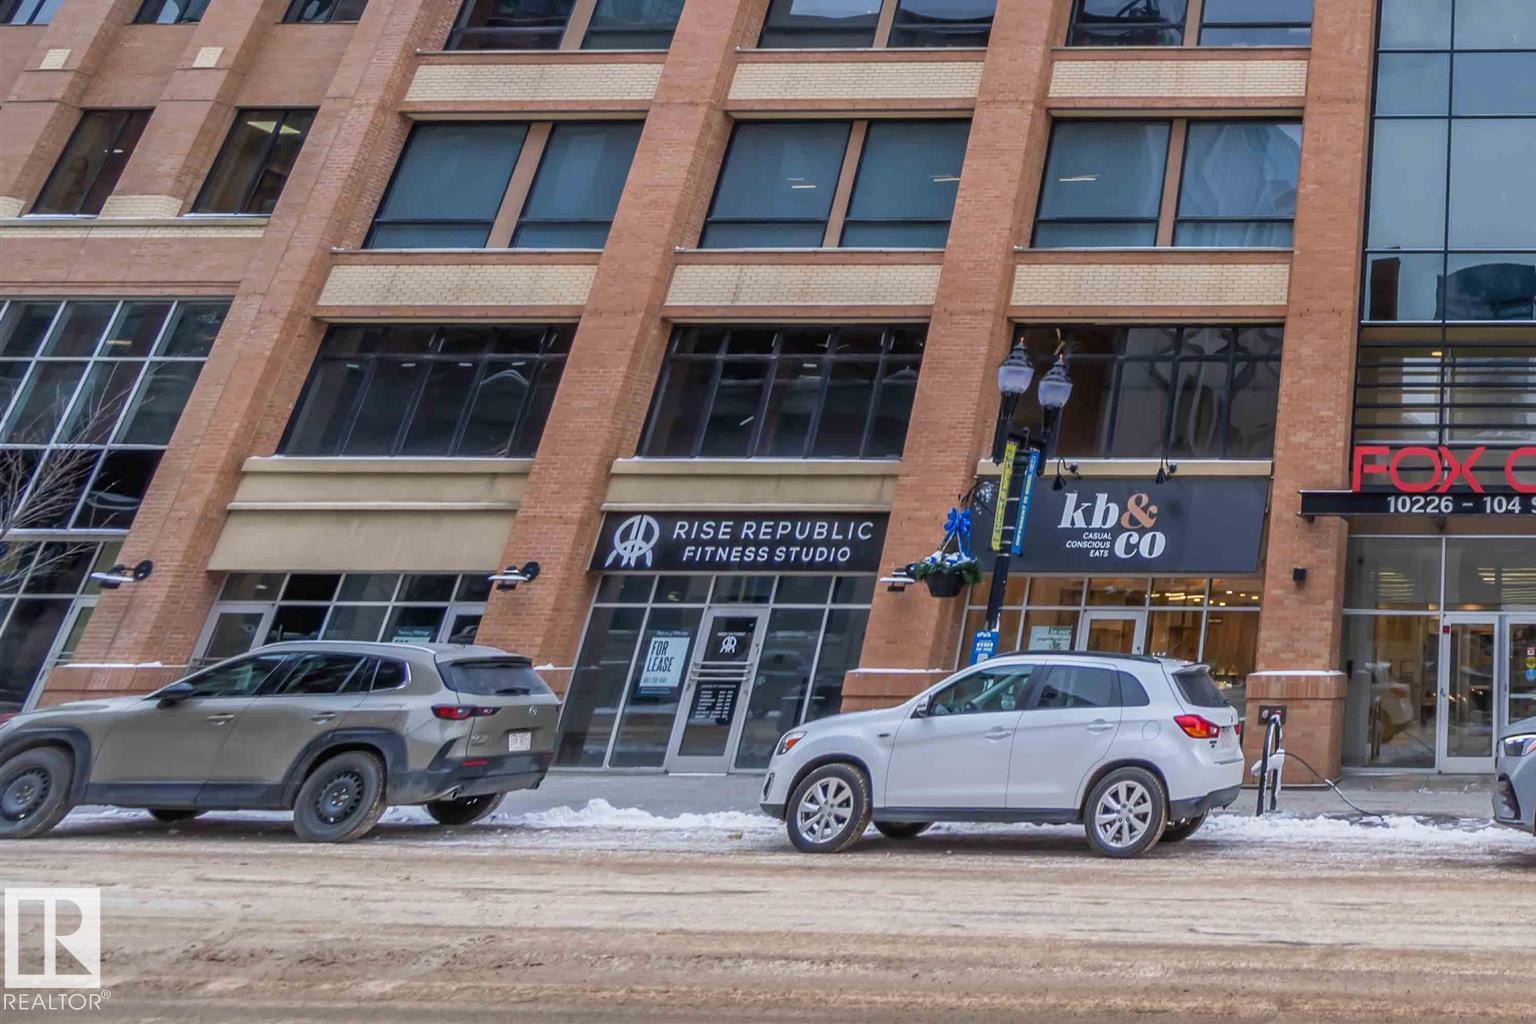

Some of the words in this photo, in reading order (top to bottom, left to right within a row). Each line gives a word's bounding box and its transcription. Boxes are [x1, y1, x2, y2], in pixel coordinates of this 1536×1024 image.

[1352, 446, 1486, 494] FOX
[1387, 496, 1453, 514] 10226
[1483, 496, 1521, 514] 104
[673, 521, 734, 540] RISE
[740, 521, 874, 540] REPUBLIC
[1083, 532, 1113, 540] CASUAL
[1066, 540, 1111, 549] CONSCIOUS
[1114, 531, 1166, 559] co
[682, 546, 769, 562] FITNESS
[774, 546, 851, 562] STUDIO
[1089, 549, 1109, 557] EATS
[651, 640, 669, 656] FOR
[646, 656, 675, 672] LEASE
